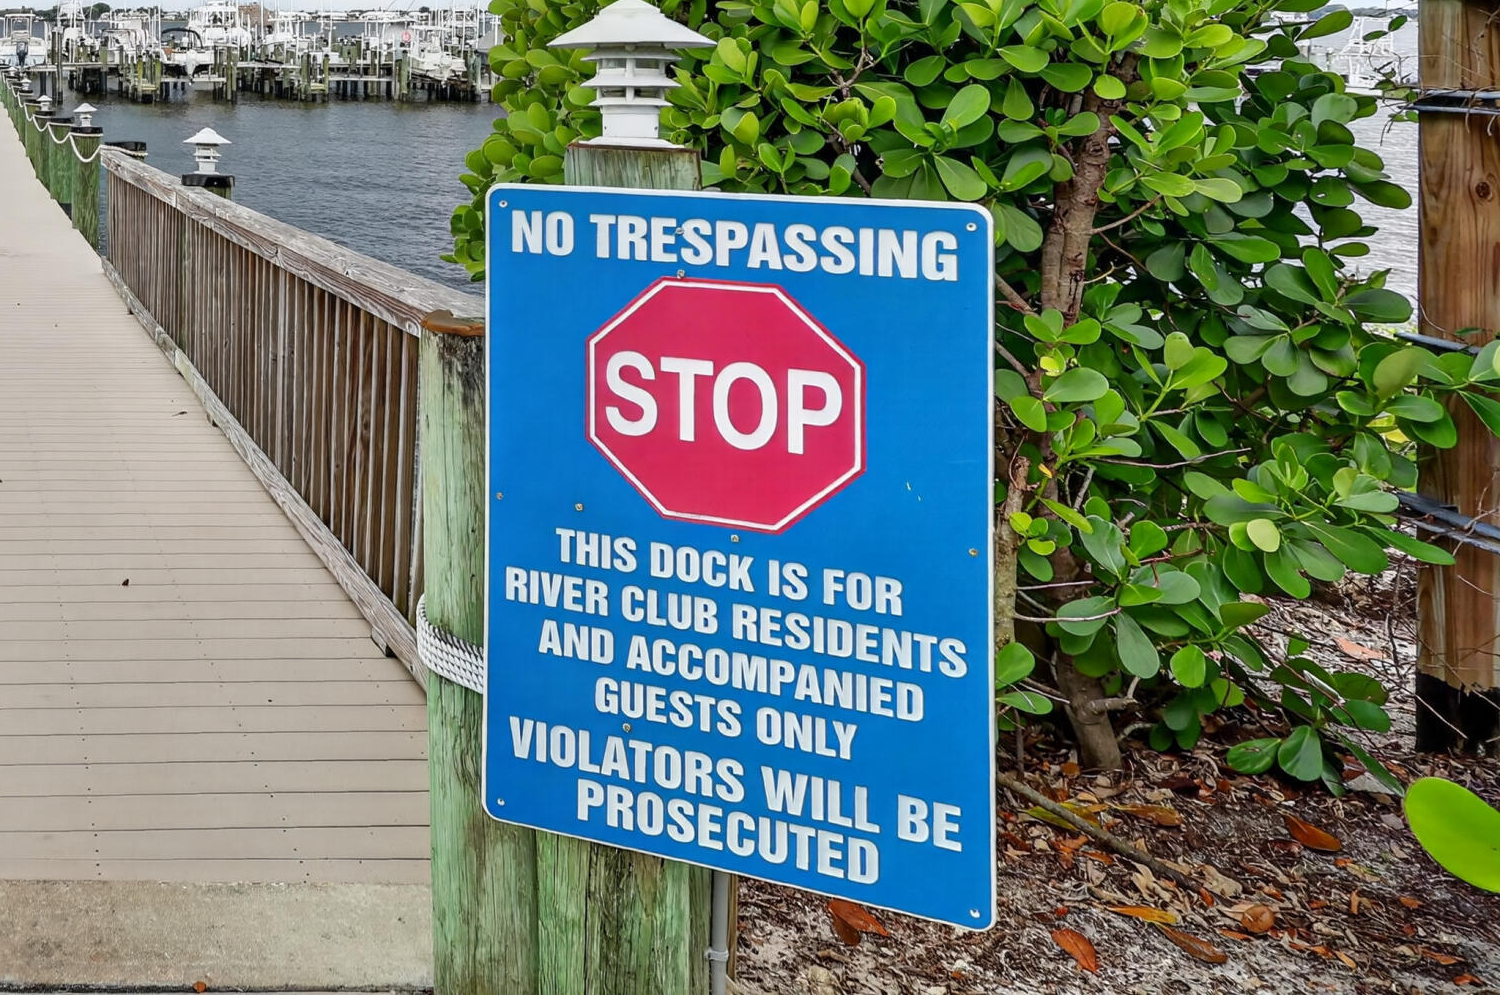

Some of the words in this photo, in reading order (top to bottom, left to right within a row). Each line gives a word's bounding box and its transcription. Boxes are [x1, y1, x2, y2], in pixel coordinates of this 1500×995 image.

[512, 210, 574, 256] NO
[589, 214, 958, 281] TRESPASSING
[605, 350, 843, 455] STOP
[505, 566, 608, 616] RIVER
[621, 585, 718, 634] CLUB
[732, 604, 967, 678] RESIDENTS
[555, 528, 637, 573] THIS
[650, 542, 755, 592] DOCK
[768, 560, 808, 600] IS
[823, 569, 902, 616] FOR
[538, 619, 614, 664] AND
[626, 635, 924, 722] ACCOMPANIED
[595, 677, 742, 737] GUESTS
[756, 707, 857, 760] ONLY
[509, 716, 745, 803] VIOLATORS
[761, 765, 880, 834] WILL
[897, 795, 962, 852] BE
[577, 778, 879, 884] PROSECUTED
